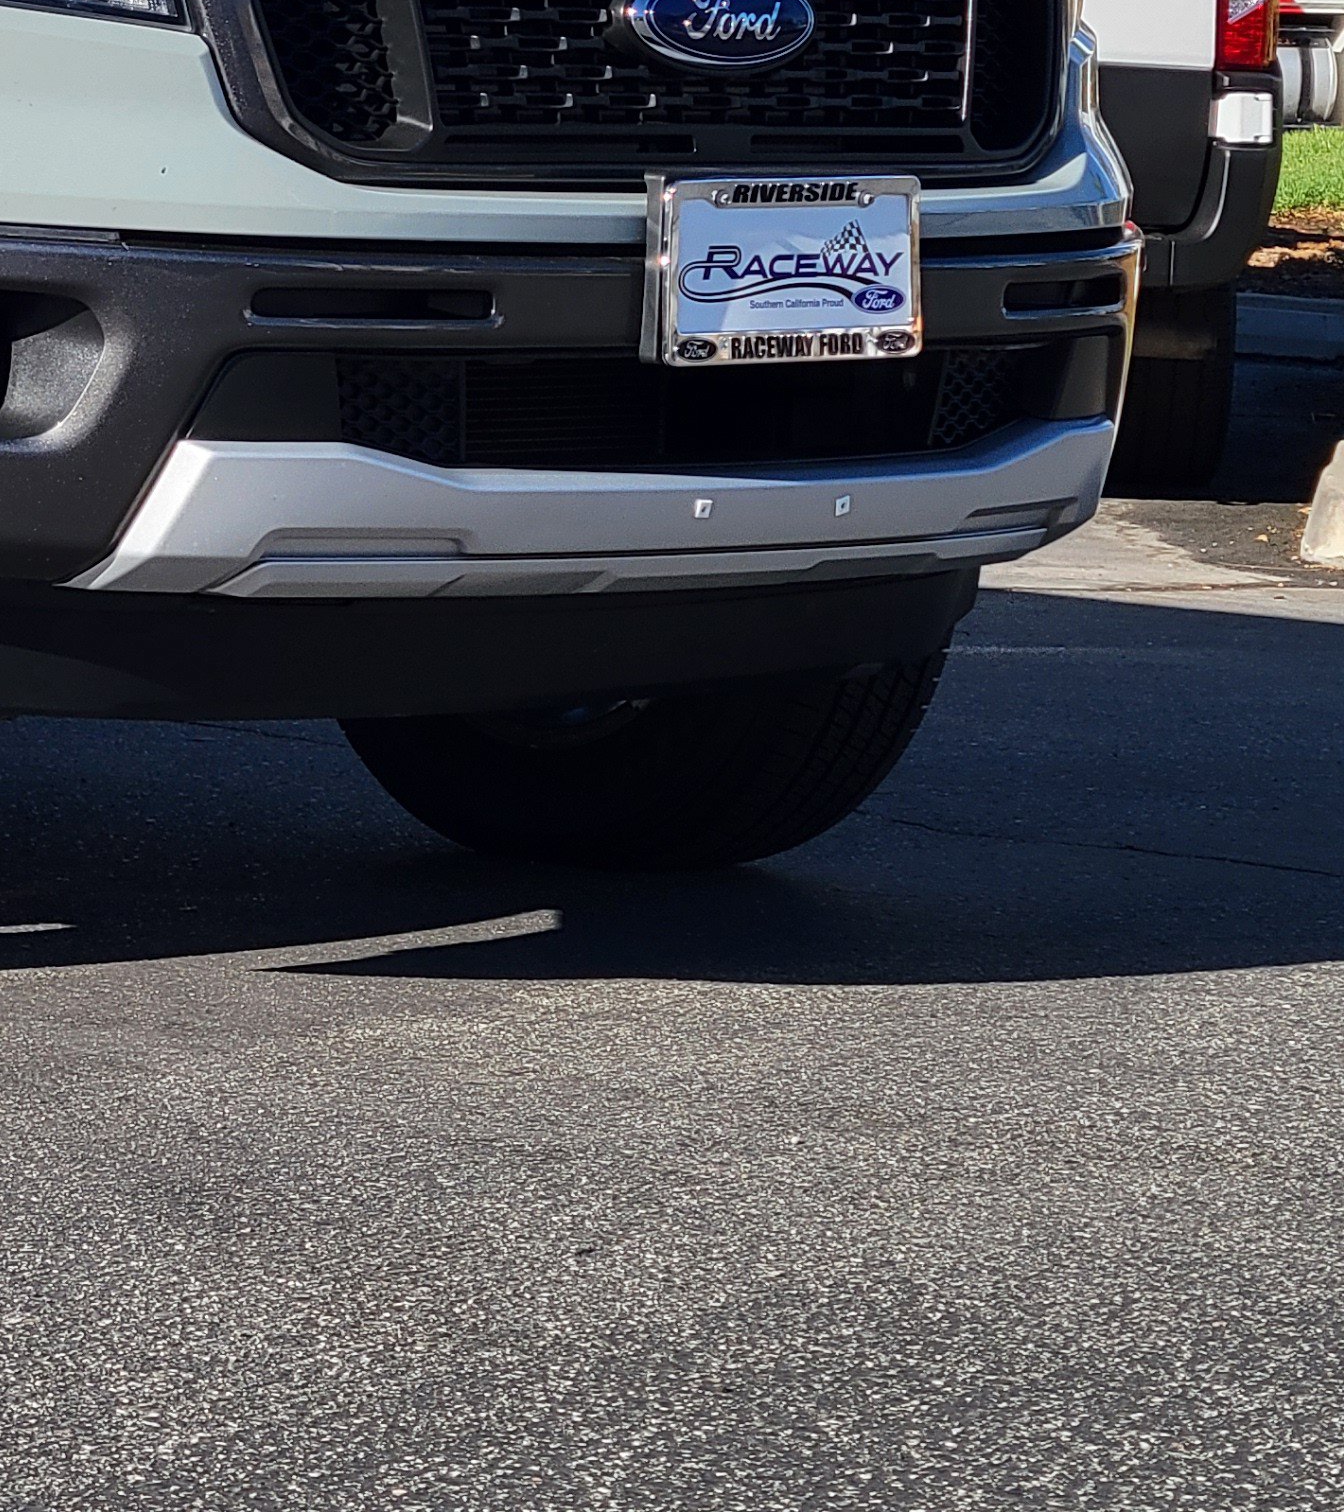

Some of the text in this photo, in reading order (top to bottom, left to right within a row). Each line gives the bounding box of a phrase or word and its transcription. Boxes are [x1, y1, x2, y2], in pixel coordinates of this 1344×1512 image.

[732, 181, 860, 204] RIVERSIDE
[701, 245, 904, 280] RACEWAY
[749, 298, 844, 309] Southern California Proud
[862, 289, 896, 312] Ford
[684, 341, 710, 358] Ford
[730, 333, 863, 360] RACEWAY FORD
